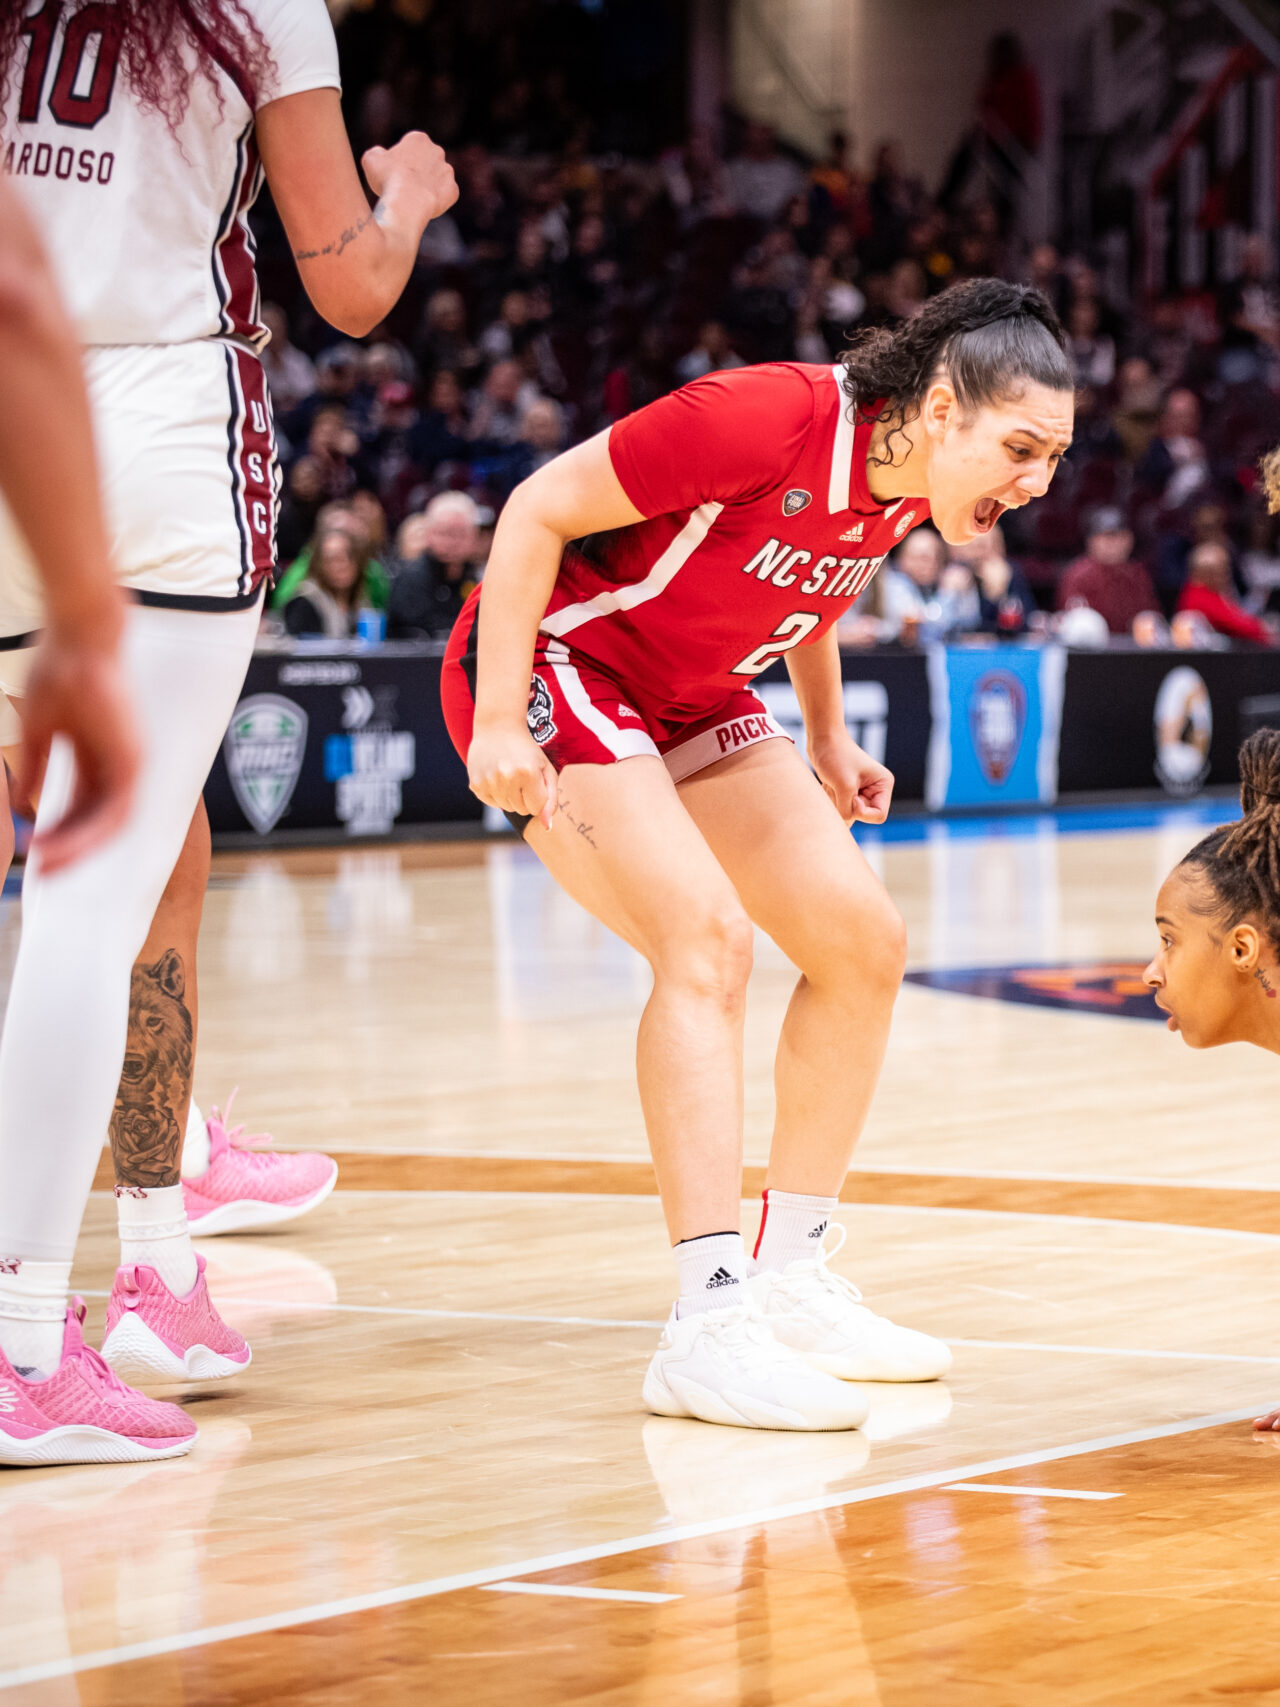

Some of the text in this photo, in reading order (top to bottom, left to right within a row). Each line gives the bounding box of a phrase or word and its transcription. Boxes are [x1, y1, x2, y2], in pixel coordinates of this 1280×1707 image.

[18, 0, 122, 130] 10
[838, 533, 864, 543] adidas
[742, 536, 888, 597] NC STAT
[729, 611, 822, 676] 2
[715, 717, 774, 753] PACK
[706, 1277, 739, 1289] adidas
